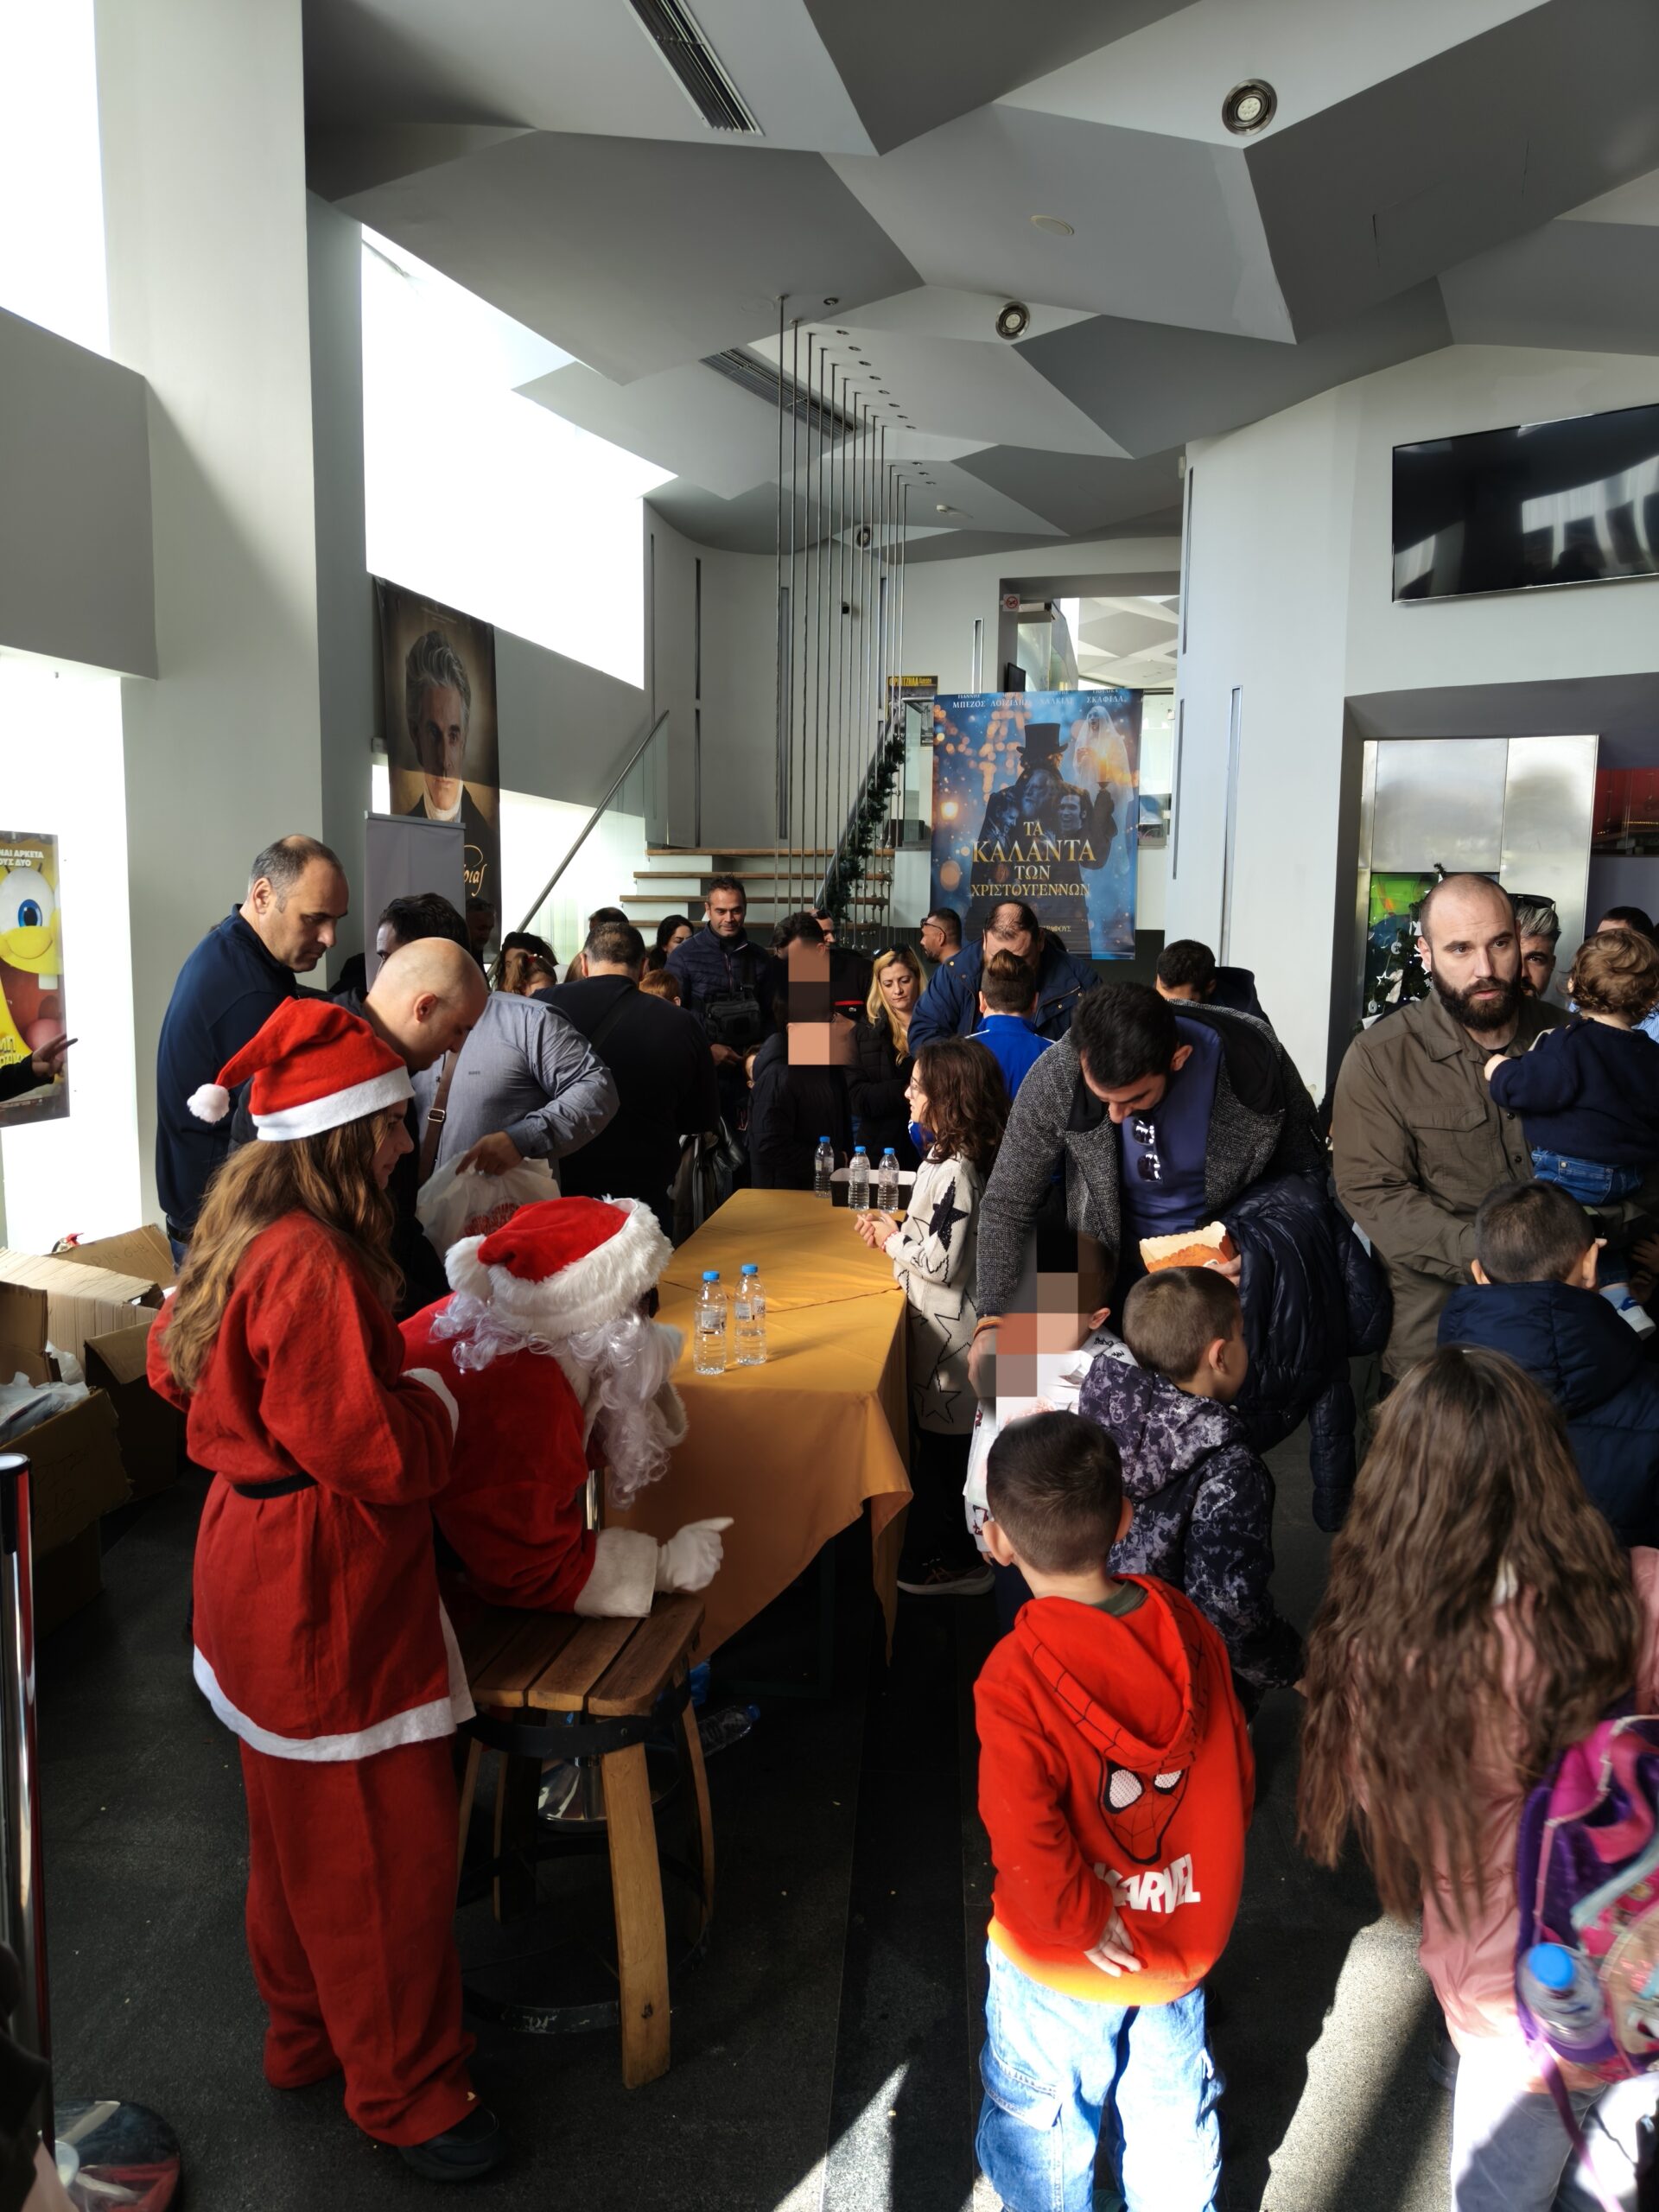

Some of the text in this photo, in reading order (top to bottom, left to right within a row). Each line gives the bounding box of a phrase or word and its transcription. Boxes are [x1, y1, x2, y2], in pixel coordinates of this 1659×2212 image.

[1023, 821, 1045, 836] ΤΑ
[972, 839, 1096, 862] ΚΑΛΑΝΤΑ
[1014, 865, 1052, 880] ΤΩΝ
[970, 883, 1090, 897] ΧΡΙΣΤΟΥΓΕΝΝΩΝ
